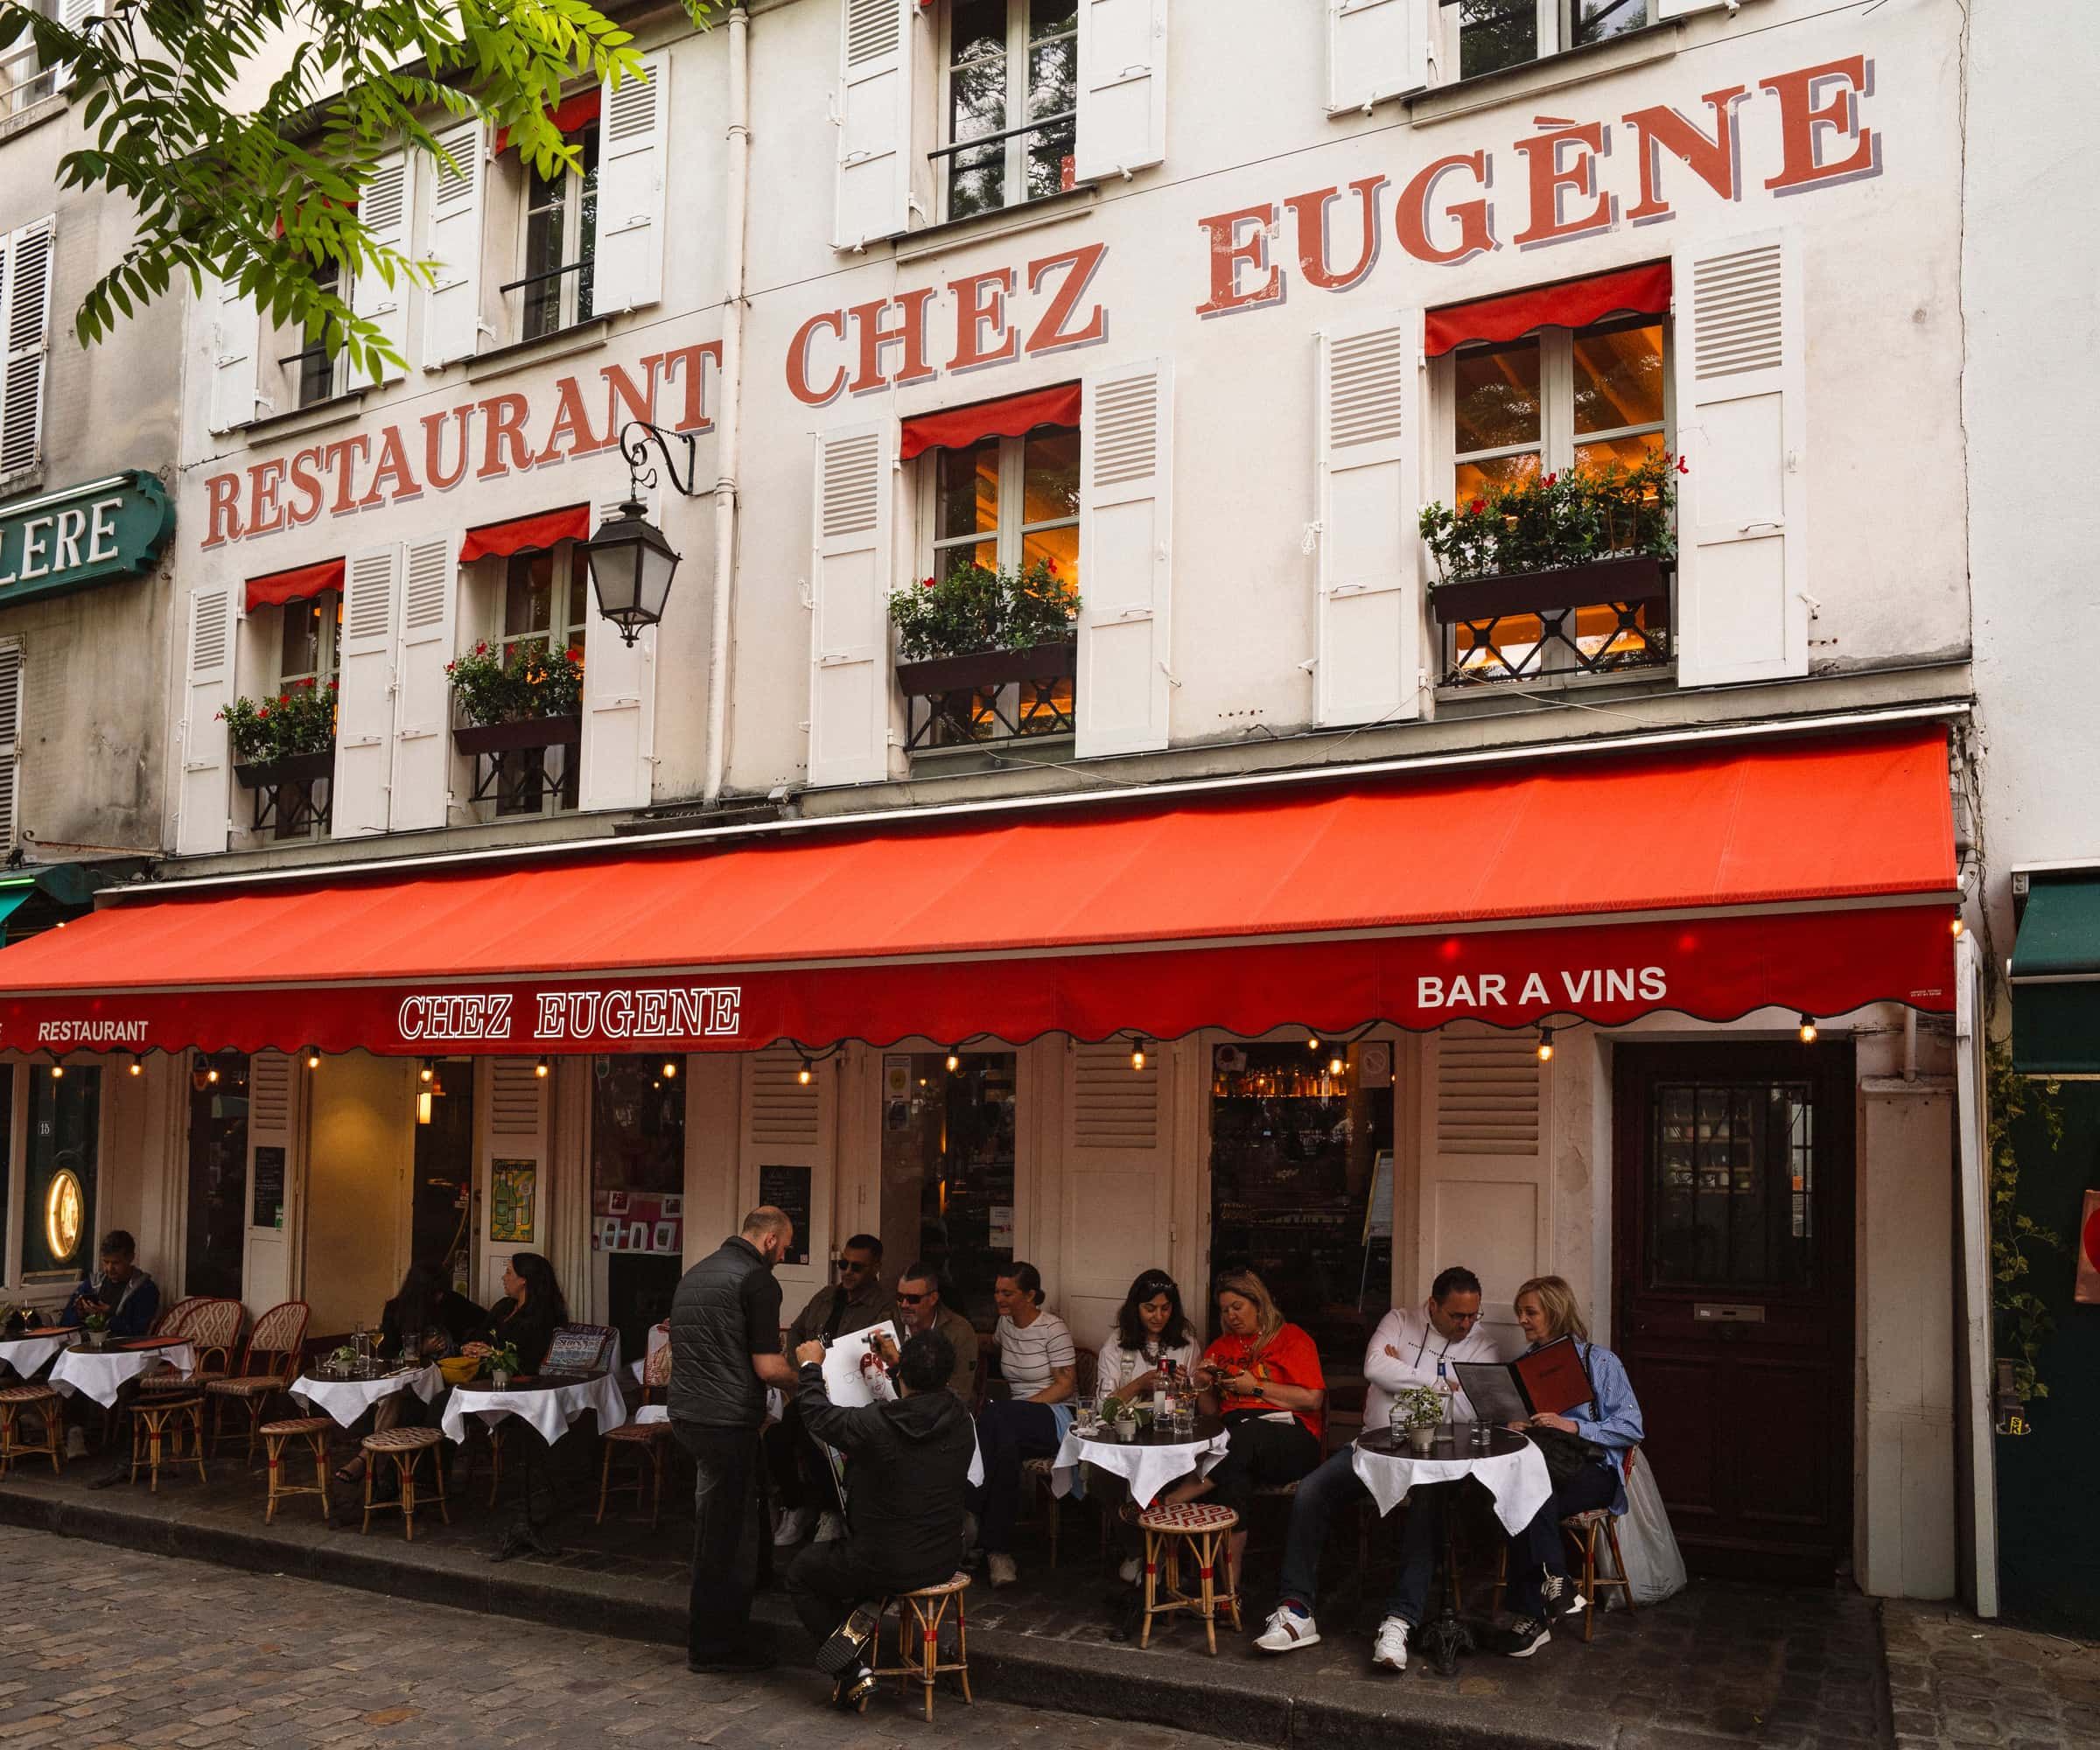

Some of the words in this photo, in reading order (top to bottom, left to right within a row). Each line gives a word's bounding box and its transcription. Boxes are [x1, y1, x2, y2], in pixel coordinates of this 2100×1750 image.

[201, 339, 723, 551] RESTAURANT
[786, 242, 1110, 408] CHEZ
[1195, 54, 1883, 320] EUGÈNE
[1418, 974, 1508, 1008] BAR
[1518, 972, 1550, 1005] A
[1560, 966, 1667, 1003] VINS
[38, 1021, 149, 1041] RESTAURANT
[398, 994, 513, 1040] CHEZ
[534, 986, 741, 1039] EUGENE
